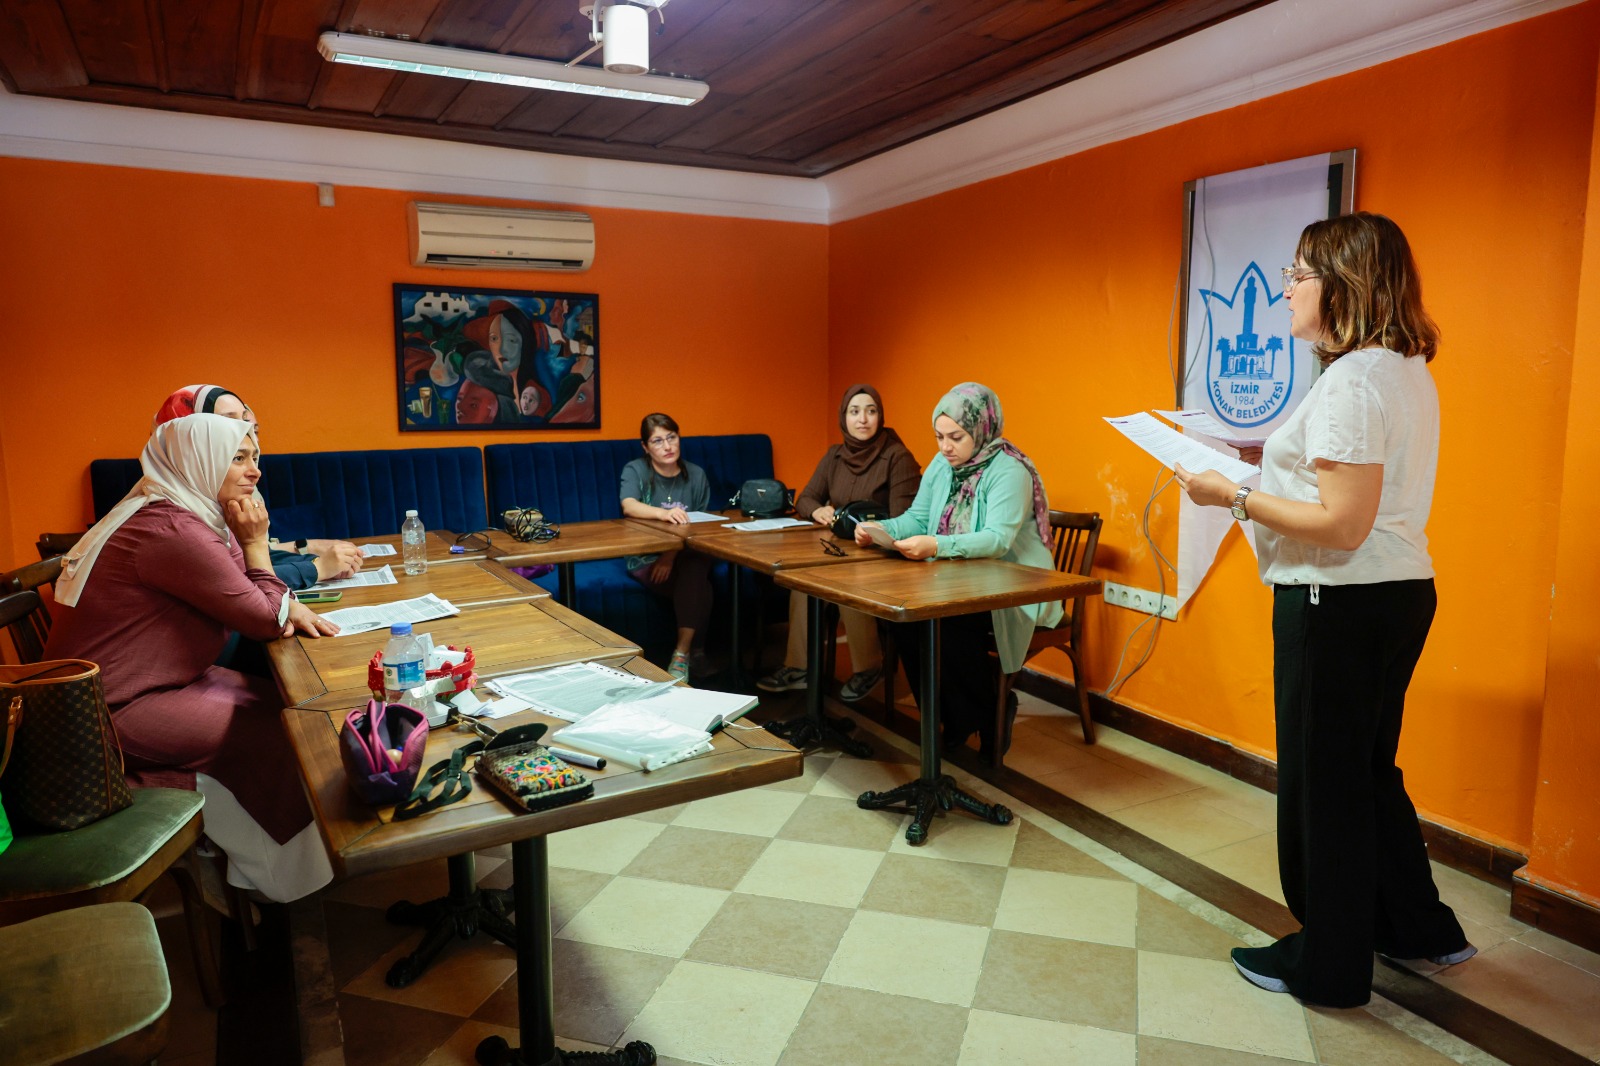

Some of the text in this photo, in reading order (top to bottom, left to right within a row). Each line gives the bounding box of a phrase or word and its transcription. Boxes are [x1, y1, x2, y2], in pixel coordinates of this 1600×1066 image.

[1230, 382, 1259, 394] İZMİR
[1213, 380, 1284, 419] KONAK BELEDİYESİ
[1234, 395, 1255, 405] 1984
